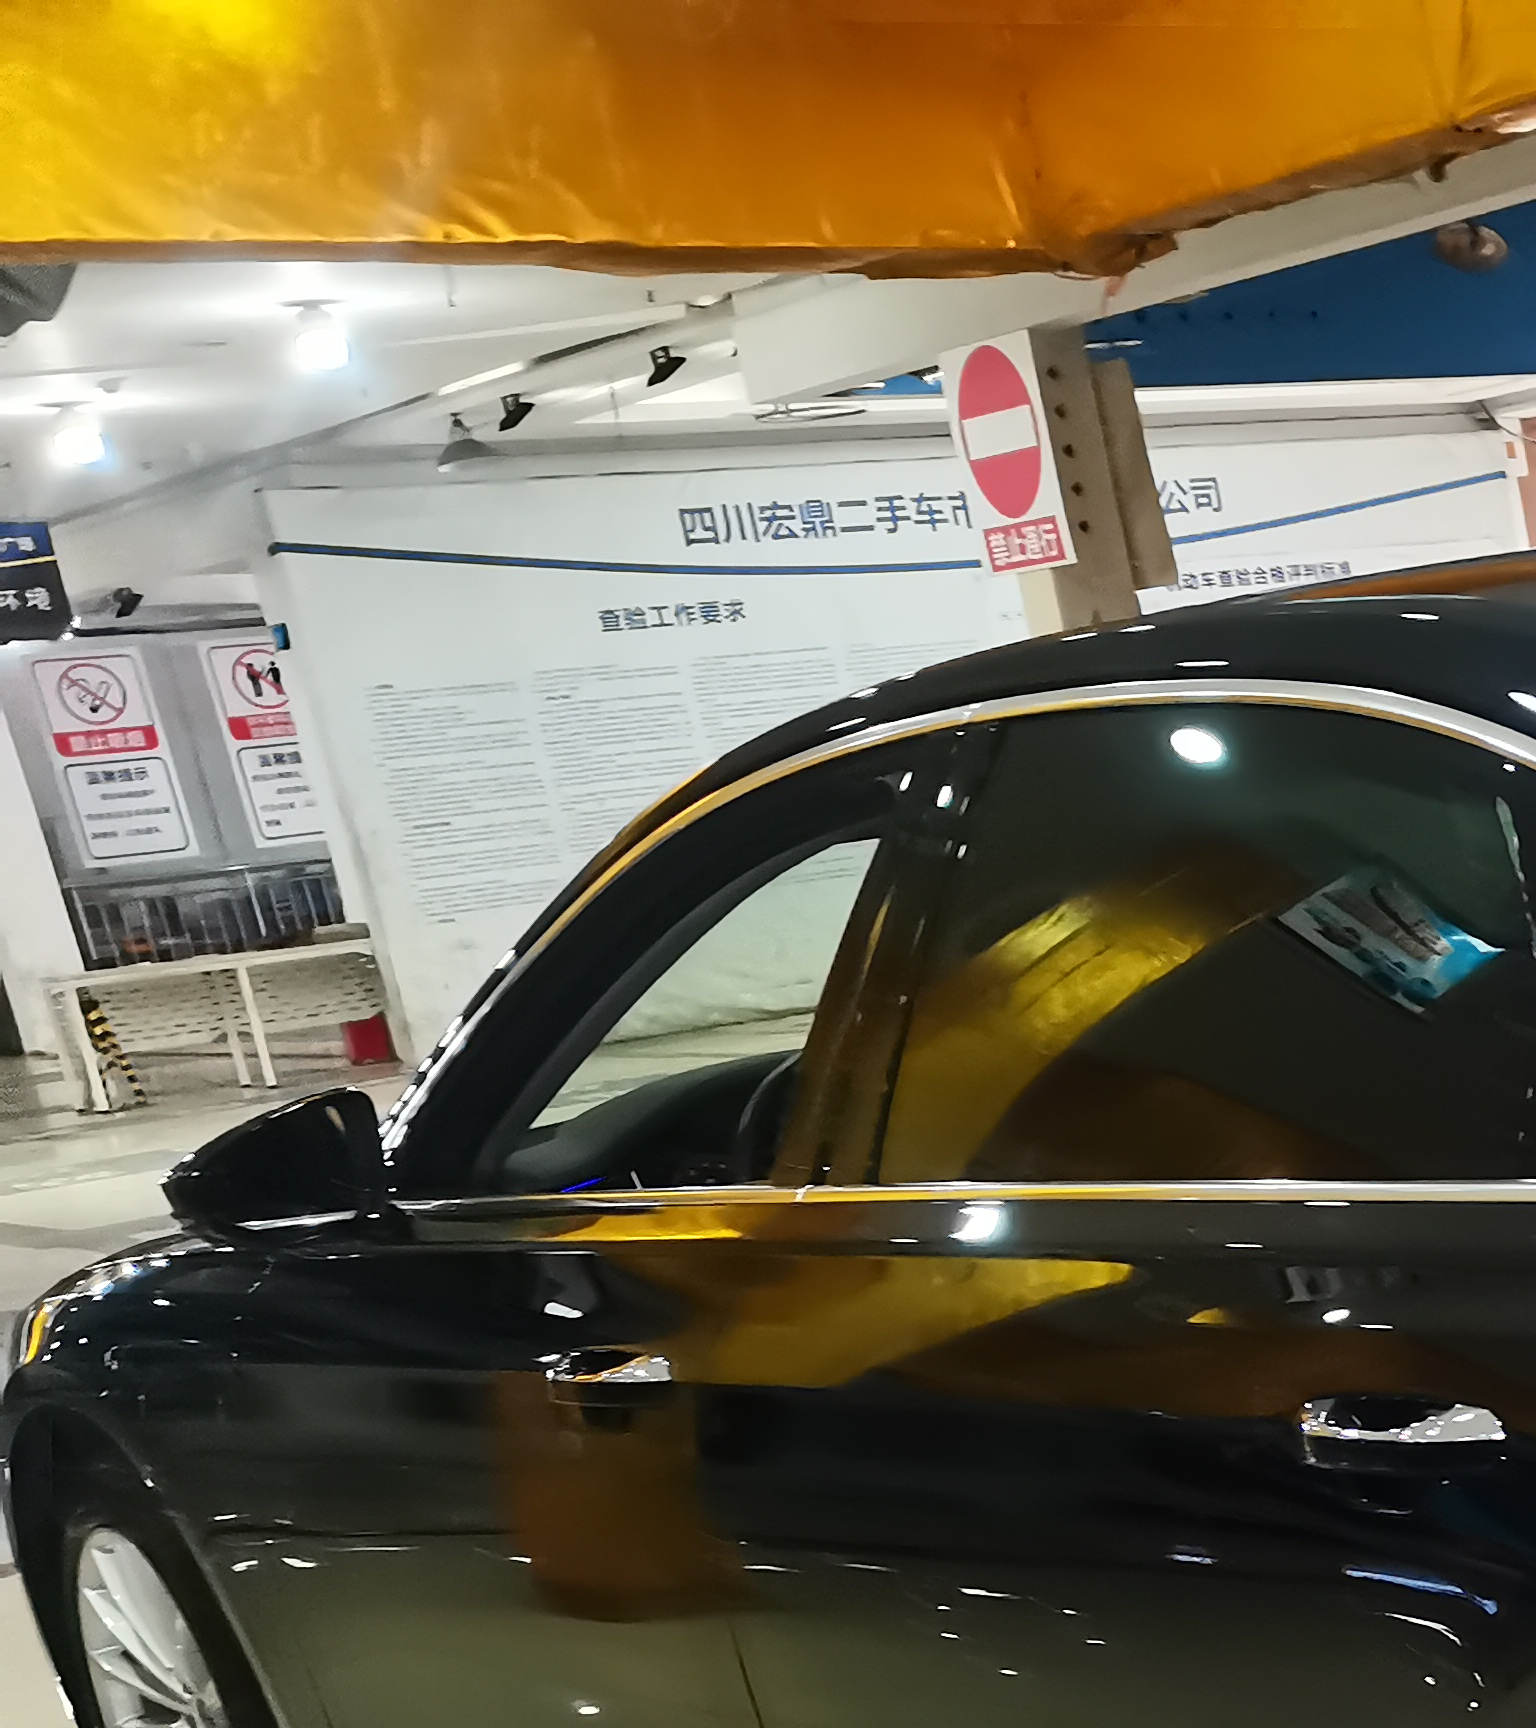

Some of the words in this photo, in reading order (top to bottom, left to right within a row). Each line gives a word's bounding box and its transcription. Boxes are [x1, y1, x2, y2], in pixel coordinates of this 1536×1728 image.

[1159, 476, 1223, 515] 公司
[1167, 561, 1351, 593] 动车查验合格评判标准
[598, 599, 747, 632] 查验工作要求
